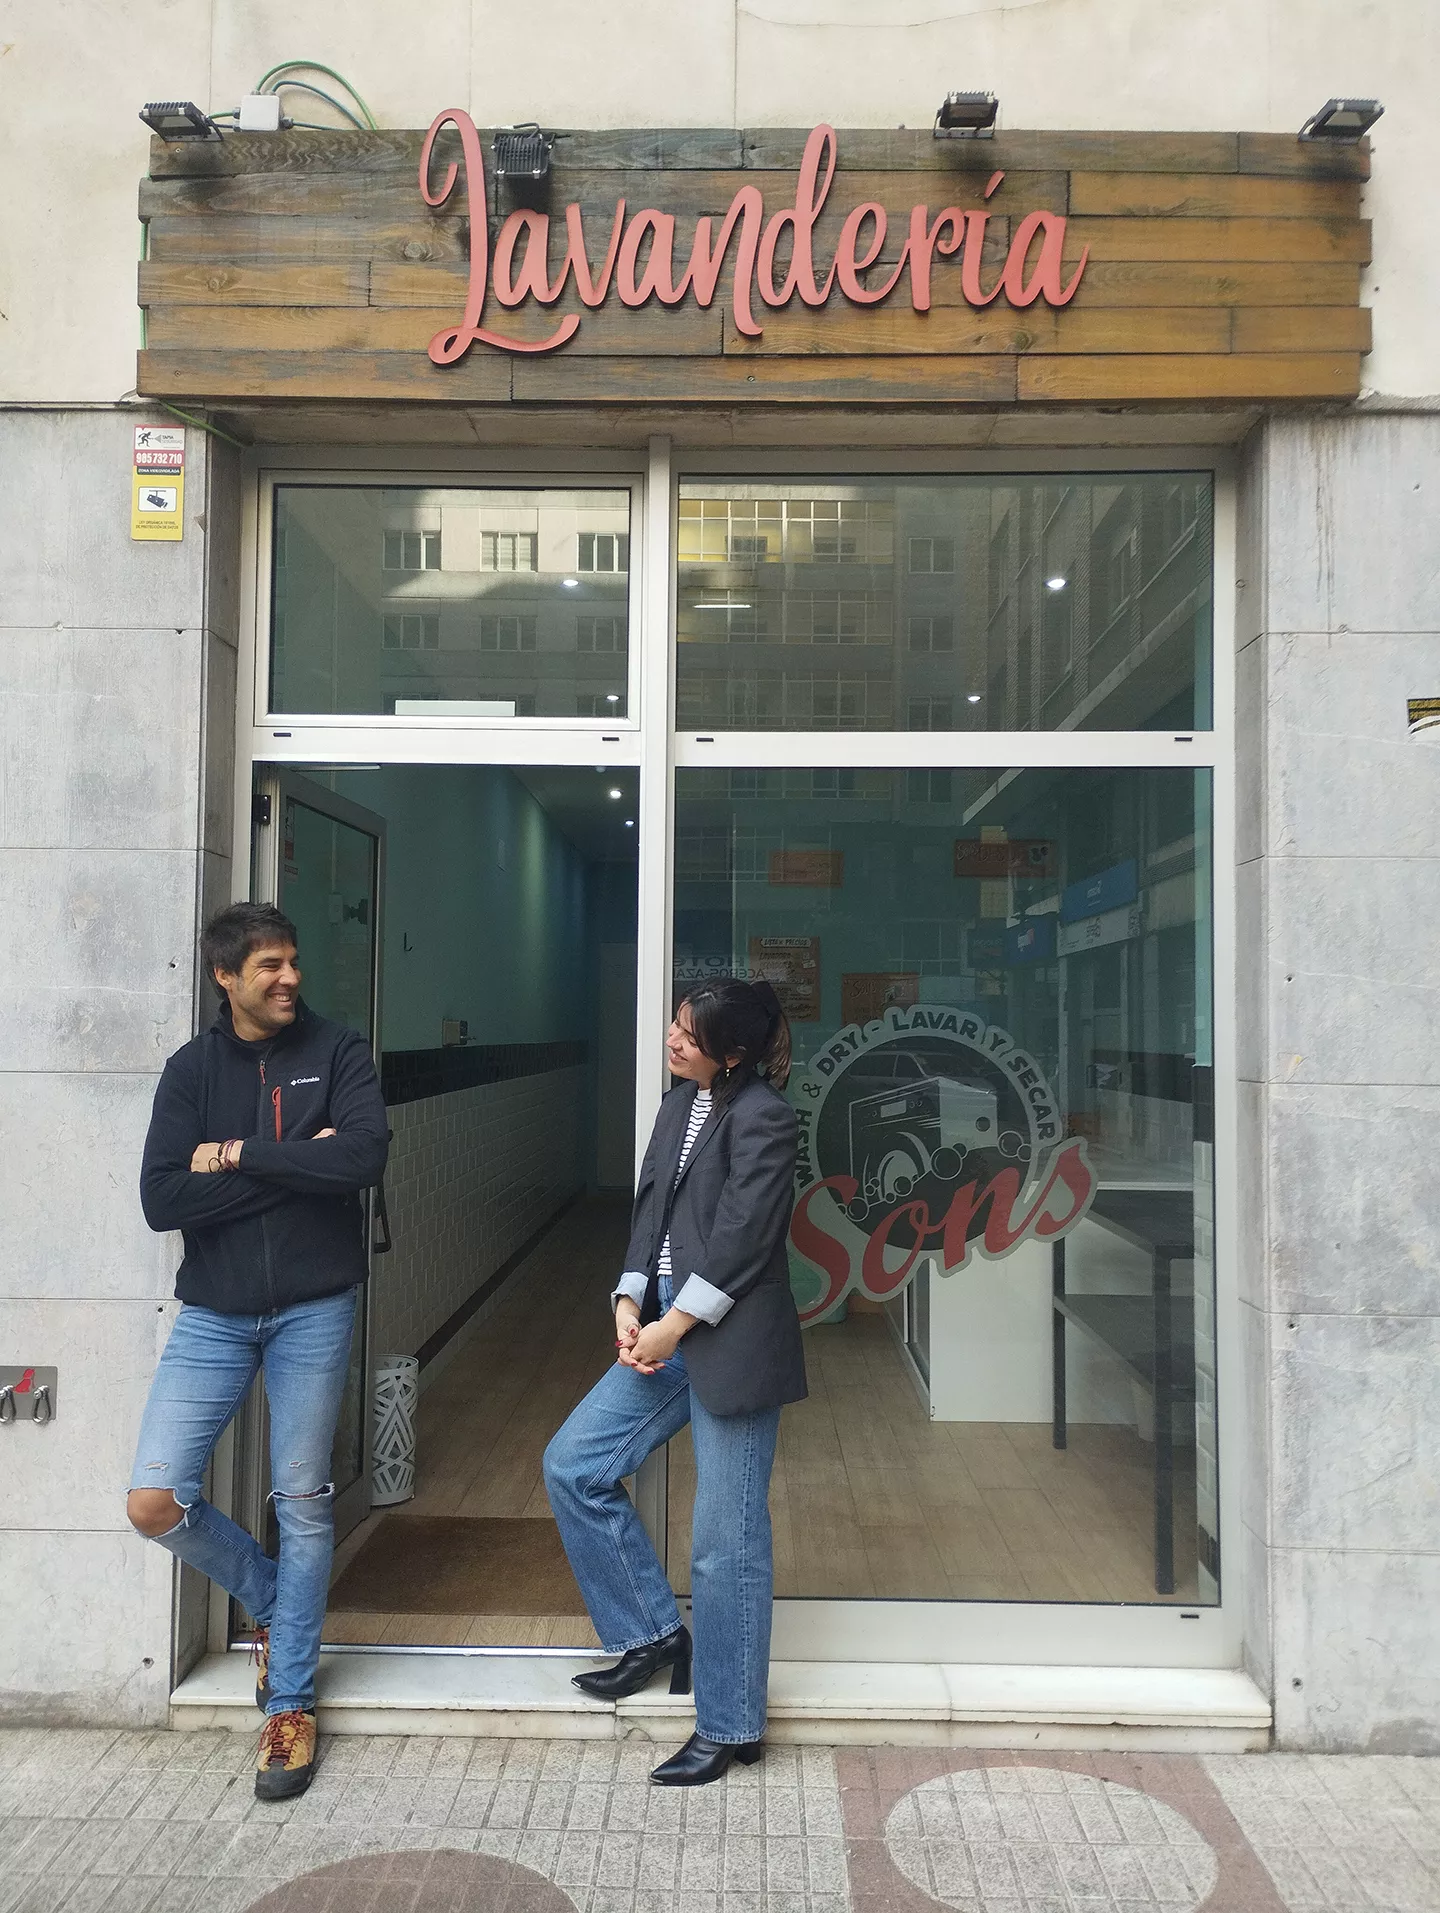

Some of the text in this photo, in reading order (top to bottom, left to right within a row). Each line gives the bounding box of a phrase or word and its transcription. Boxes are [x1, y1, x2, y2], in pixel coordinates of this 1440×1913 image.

[419, 108, 1090, 364] Lavandería
[136, 452, 183, 464] 985 732 710
[892, 1011, 979, 1040] LAVAR
[989, 1031, 1008, 1051] Y
[816, 1030, 864, 1076] DRY
[802, 1081, 823, 1098] &
[1006, 1055, 1056, 1141] SECAR
[796, 1108, 815, 1188] WASH
[790, 1143, 1092, 1322] Sons
